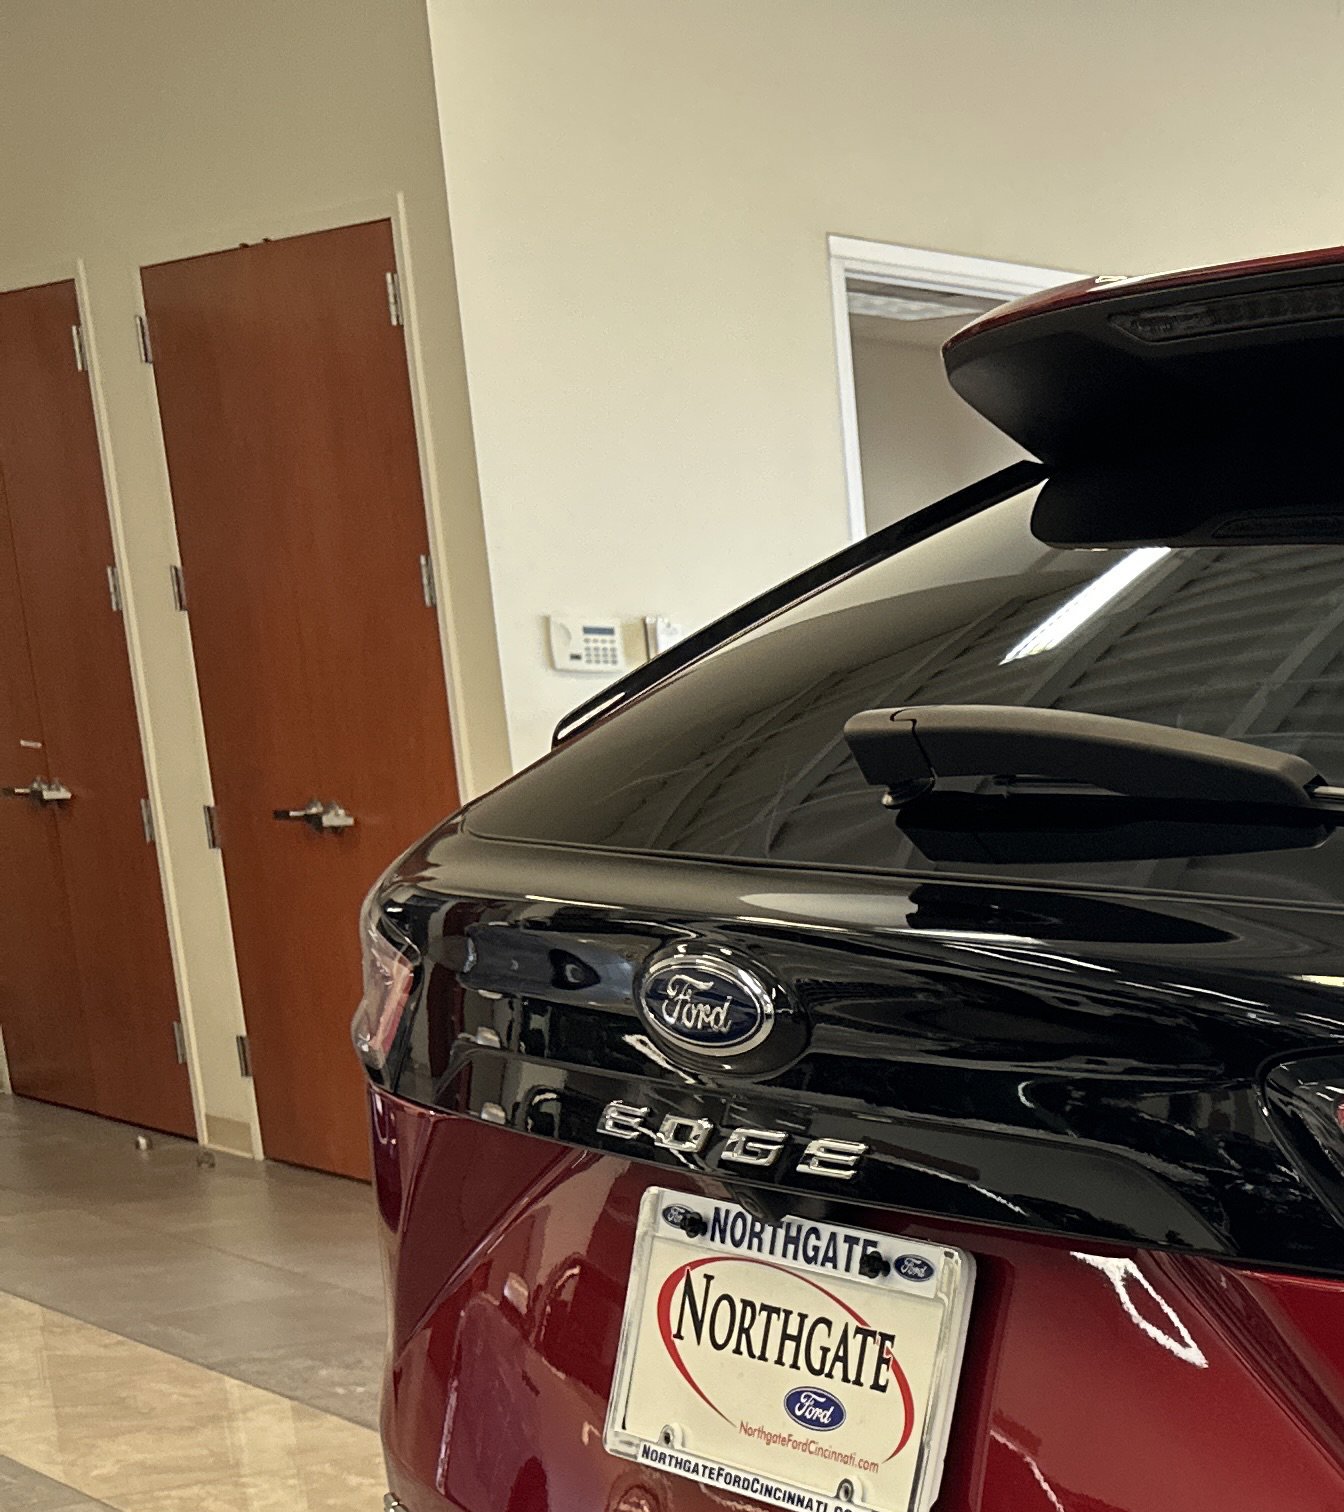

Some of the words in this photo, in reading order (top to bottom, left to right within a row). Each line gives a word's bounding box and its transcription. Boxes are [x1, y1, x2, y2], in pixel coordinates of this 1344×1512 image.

[661, 973, 733, 1034] Ford
[596, 1099, 868, 1180] EDGE
[900, 1256, 927, 1279] Ford
[673, 1268, 896, 1394] NORTHGATE
[794, 1391, 835, 1424] Ford
[739, 1420, 880, 1474] NorthgateFordCincinnati.com
